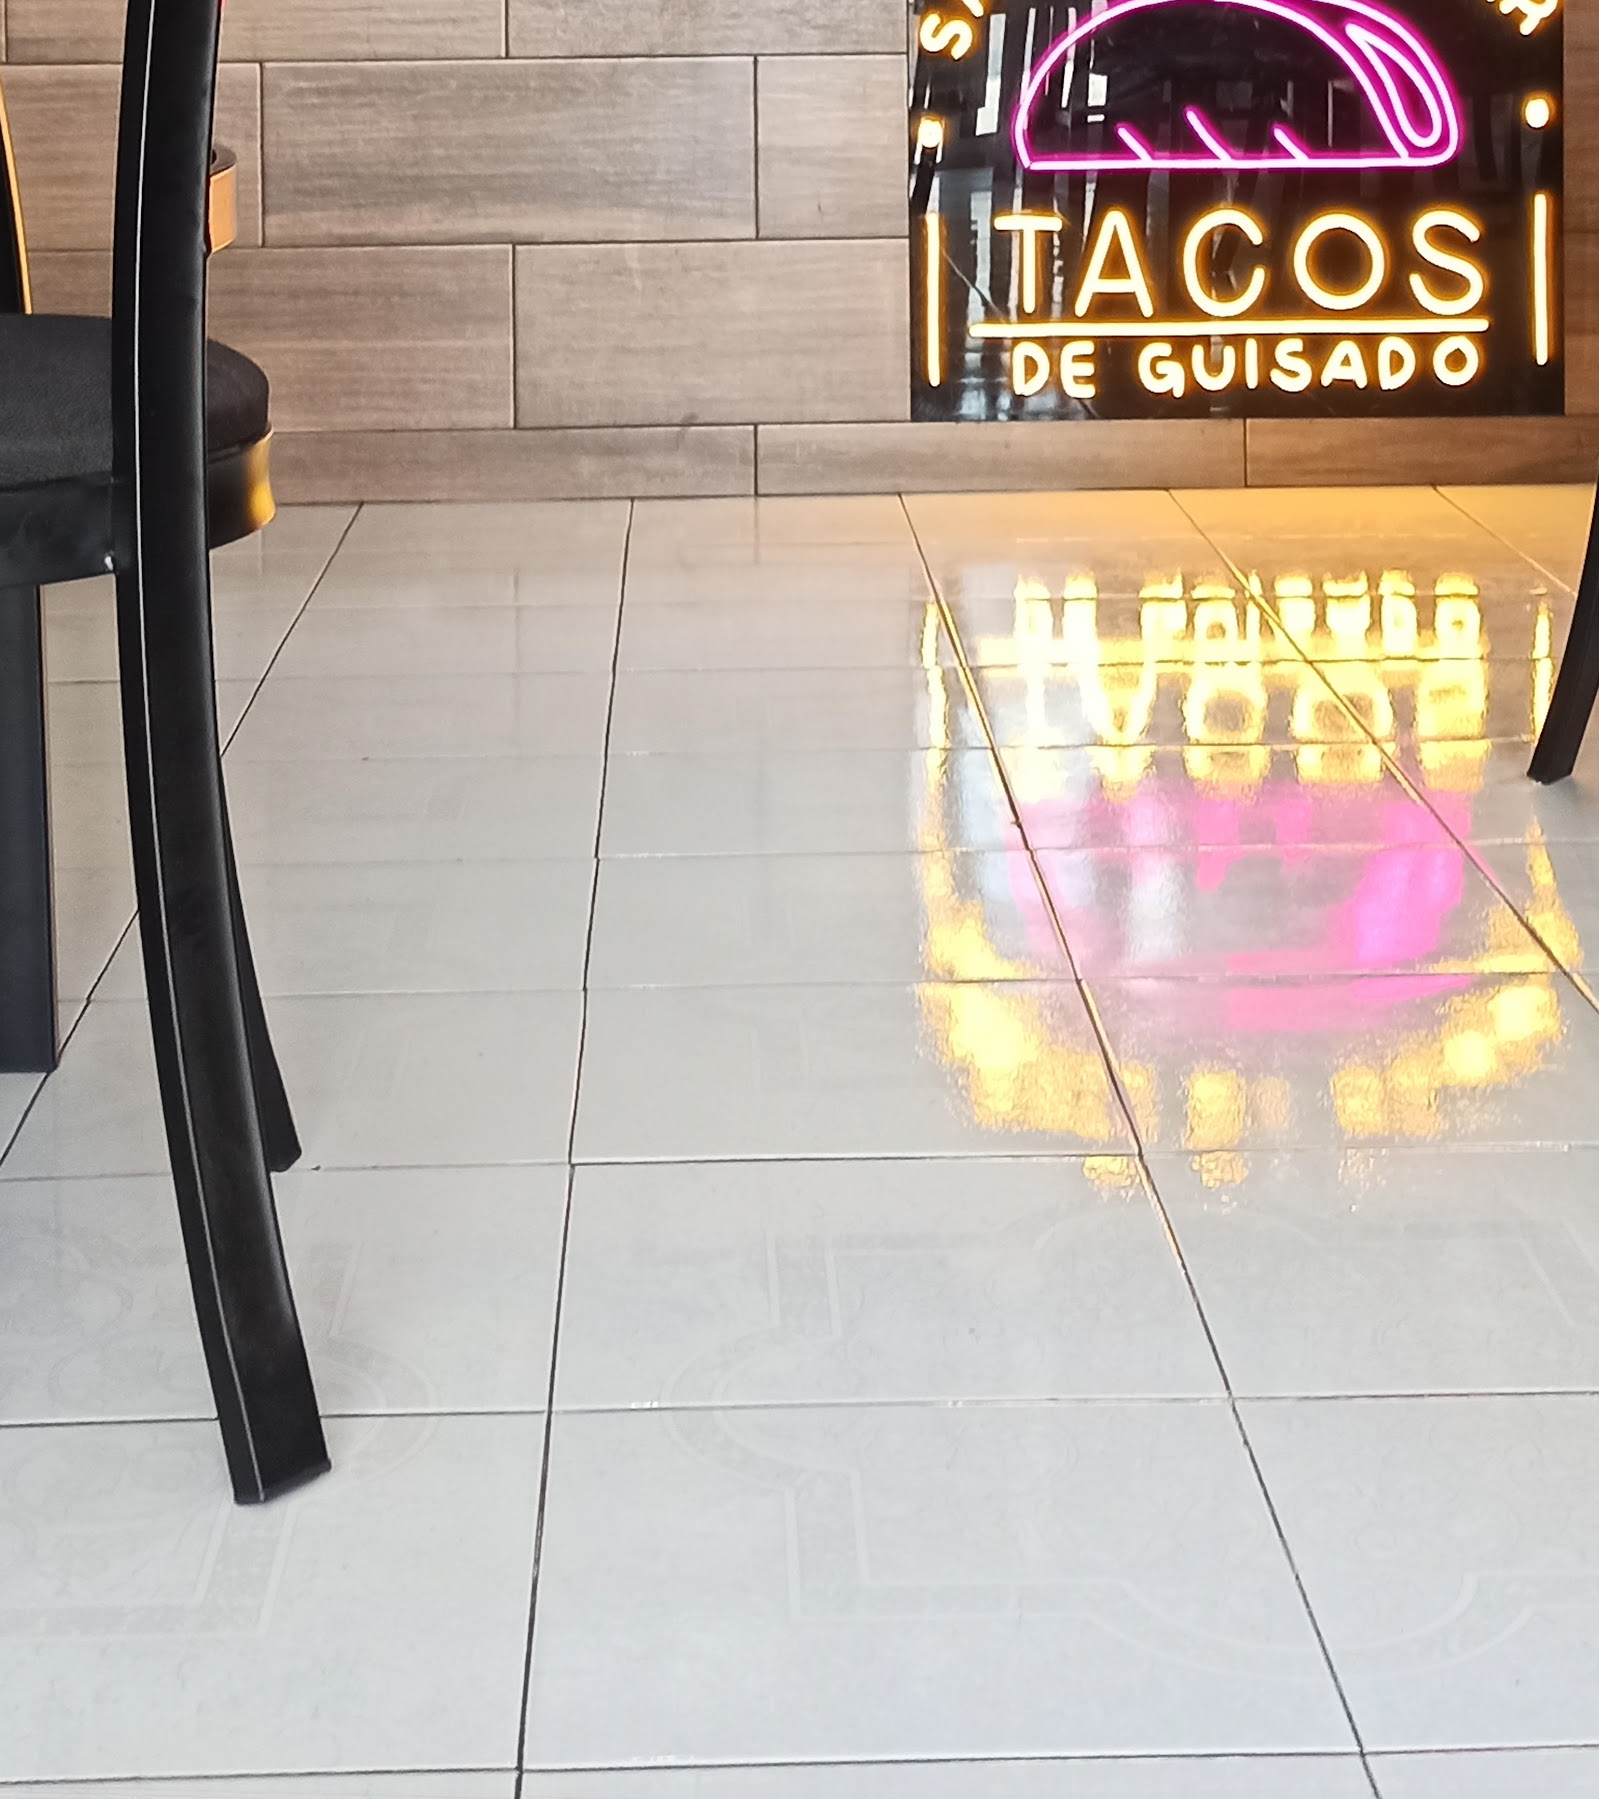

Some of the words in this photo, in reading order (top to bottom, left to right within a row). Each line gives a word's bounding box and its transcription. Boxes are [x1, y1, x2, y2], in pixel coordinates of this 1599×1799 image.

[993, 208, 1485, 318] TACOS
[1011, 339, 1096, 399] DE
[1137, 335, 1480, 398] GUISADO
